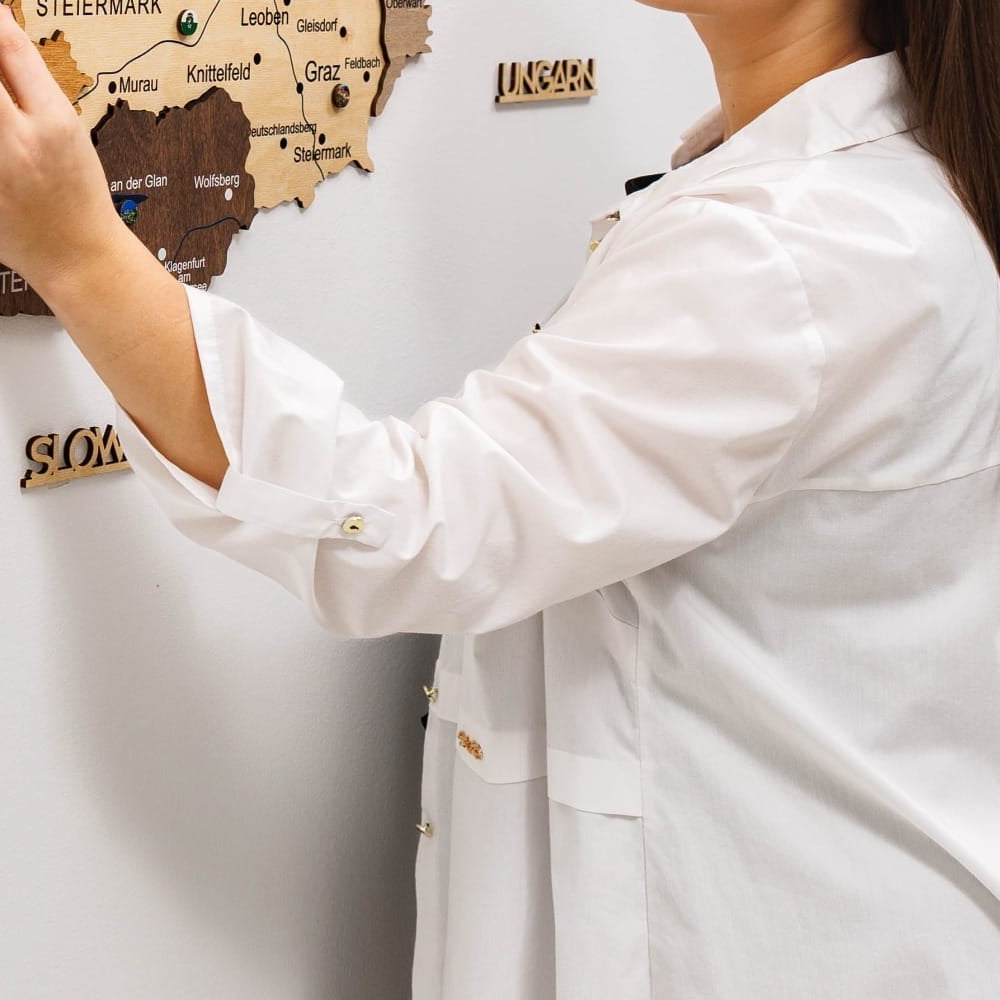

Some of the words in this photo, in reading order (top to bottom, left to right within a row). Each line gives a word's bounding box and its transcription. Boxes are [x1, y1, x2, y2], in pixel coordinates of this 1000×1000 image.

[241, 7, 289, 27] Leoben
[297, 18, 339, 34] Gleisdorf
[305, 60, 341, 83] Graz
[344, 56, 381, 70] Feldbach
[187, 62, 251, 84] Knittelfeld
[495, 58, 597, 103] UNGARN
[119, 76, 158, 94] Murau
[294, 142, 352, 164] Steiermark
[110, 180, 123, 192] an
[126, 177, 143, 191] der
[145, 174, 168, 188] Glan
[194, 173, 240, 190] Wolfsberg
[164, 256, 206, 274] Klagenfurt
[178, 273, 191, 283] am
